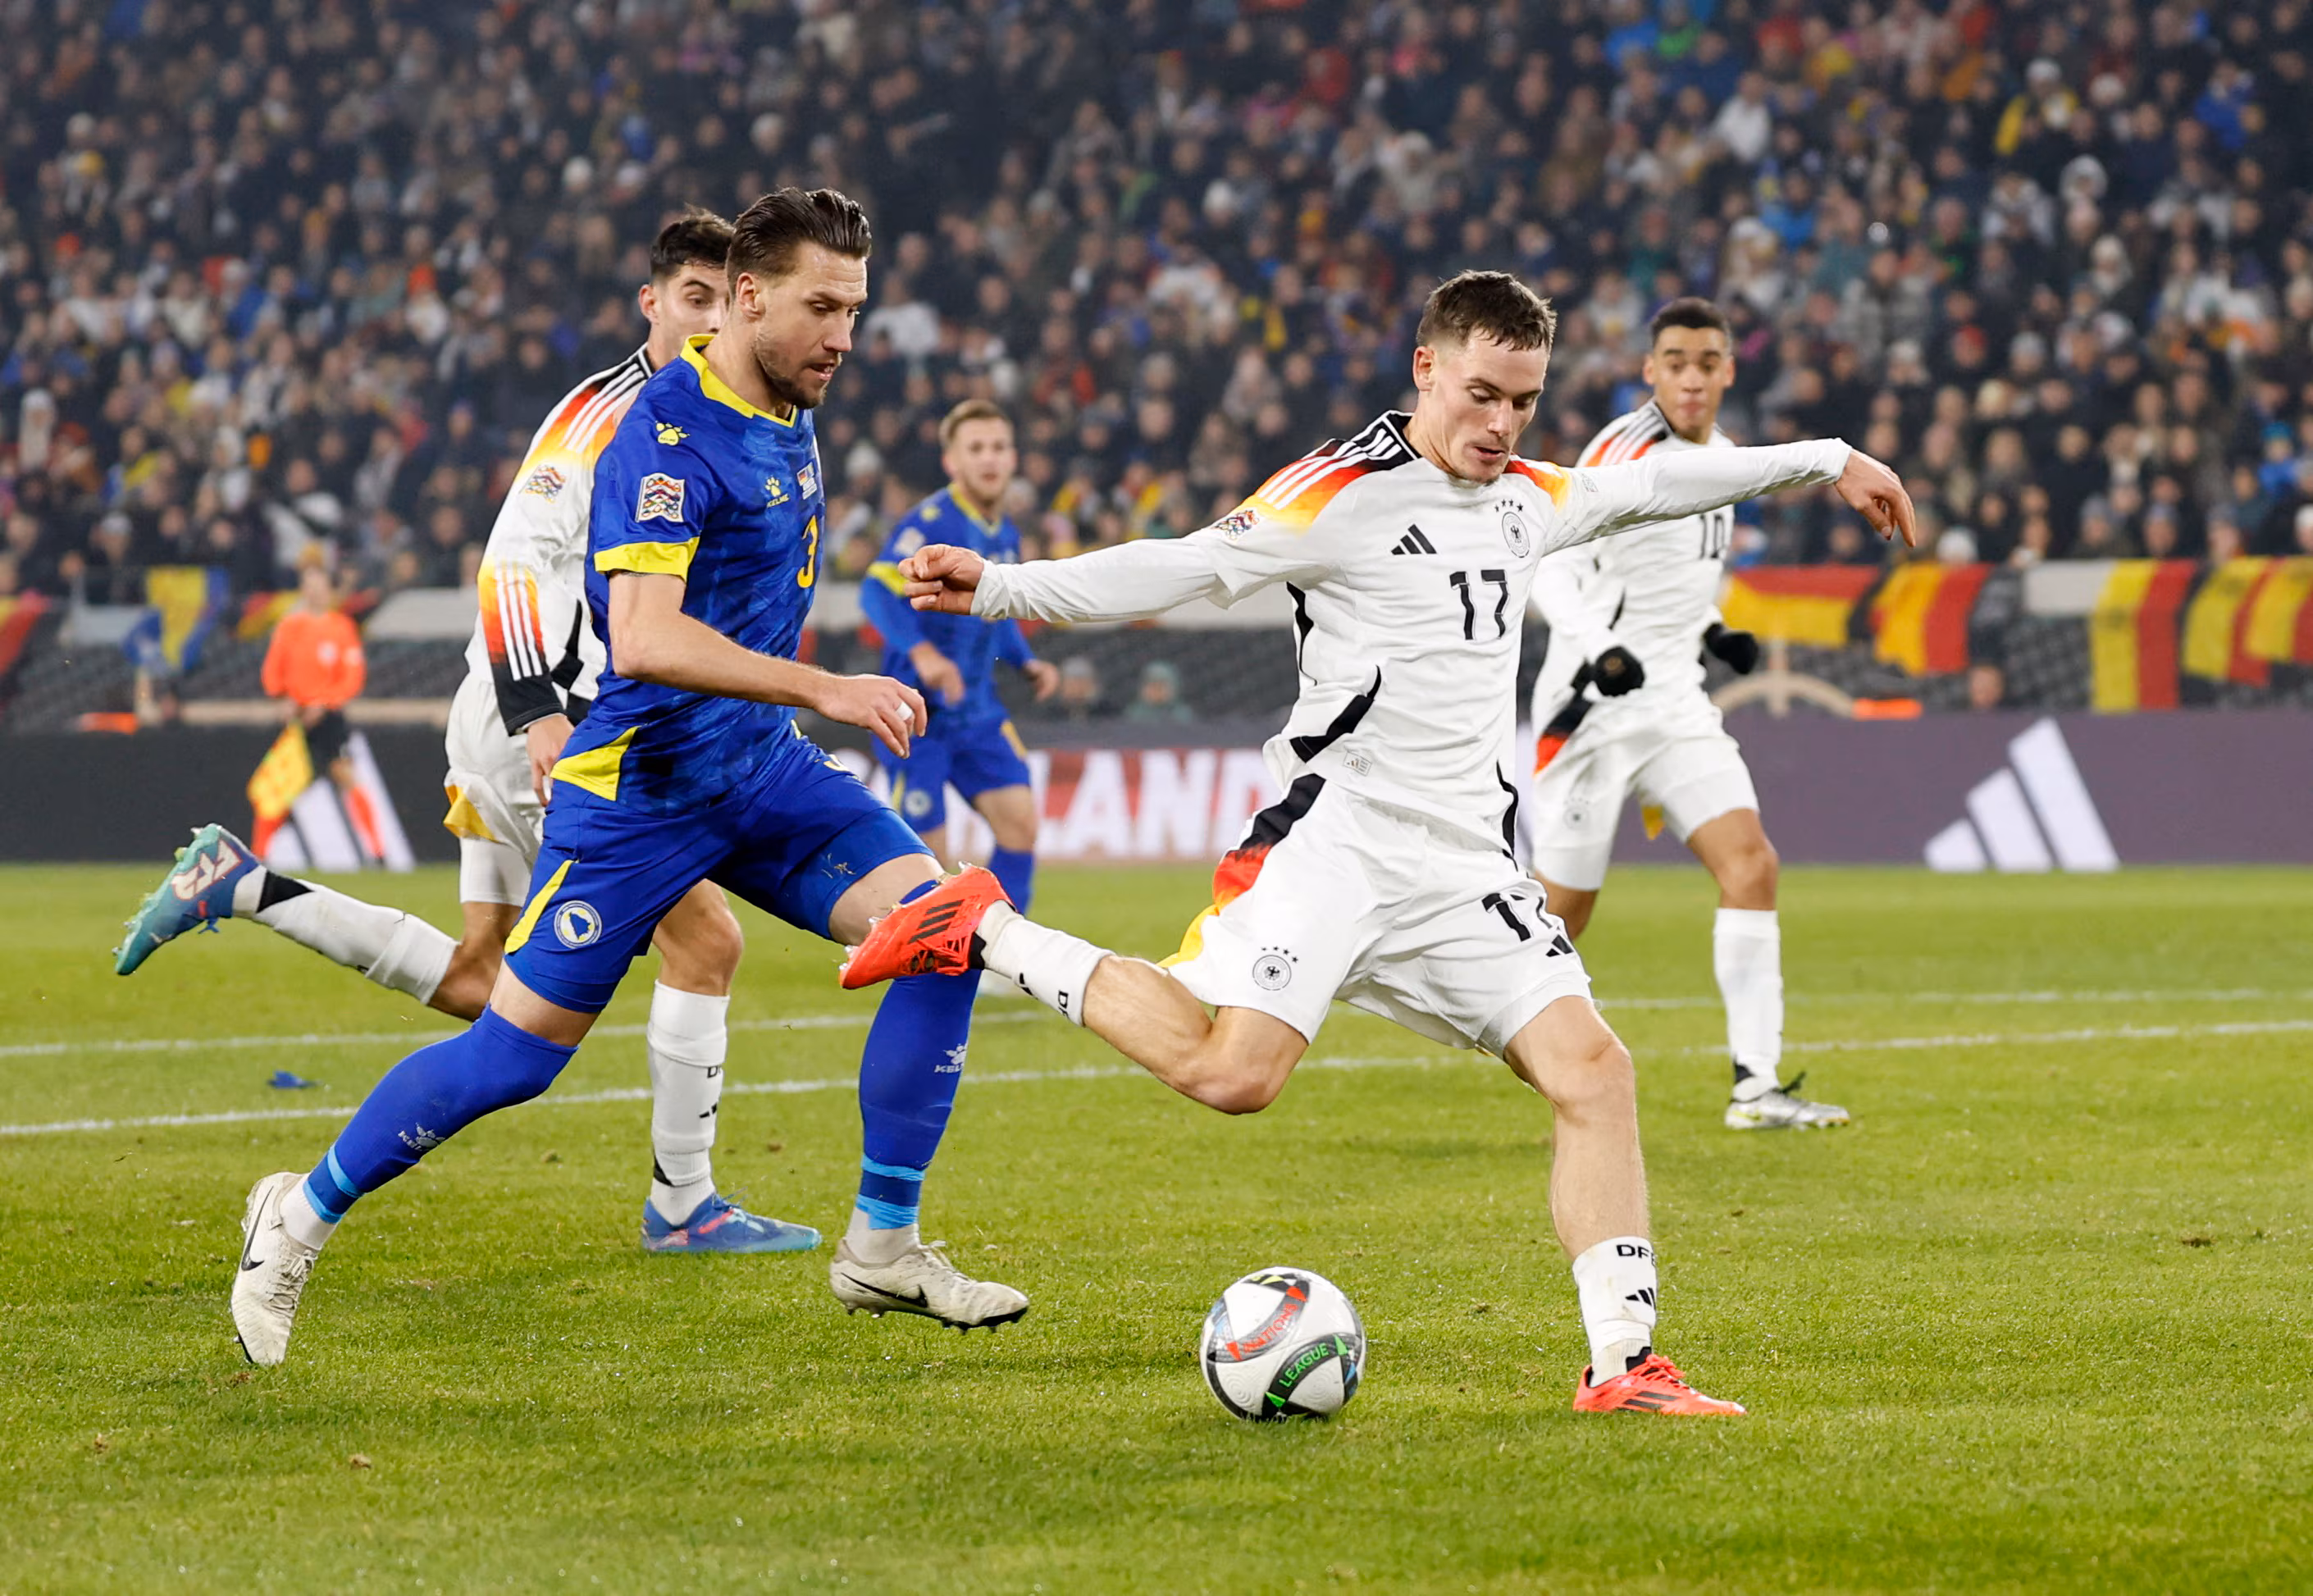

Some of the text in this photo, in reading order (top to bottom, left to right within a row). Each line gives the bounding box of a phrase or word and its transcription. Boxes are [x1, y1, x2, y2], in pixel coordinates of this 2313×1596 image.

[796, 514, 819, 589] 3
[1449, 568, 1509, 641] 17
[934, 1064, 963, 1074] KEL
[1279, 1342, 1330, 1388] LEAGUE
